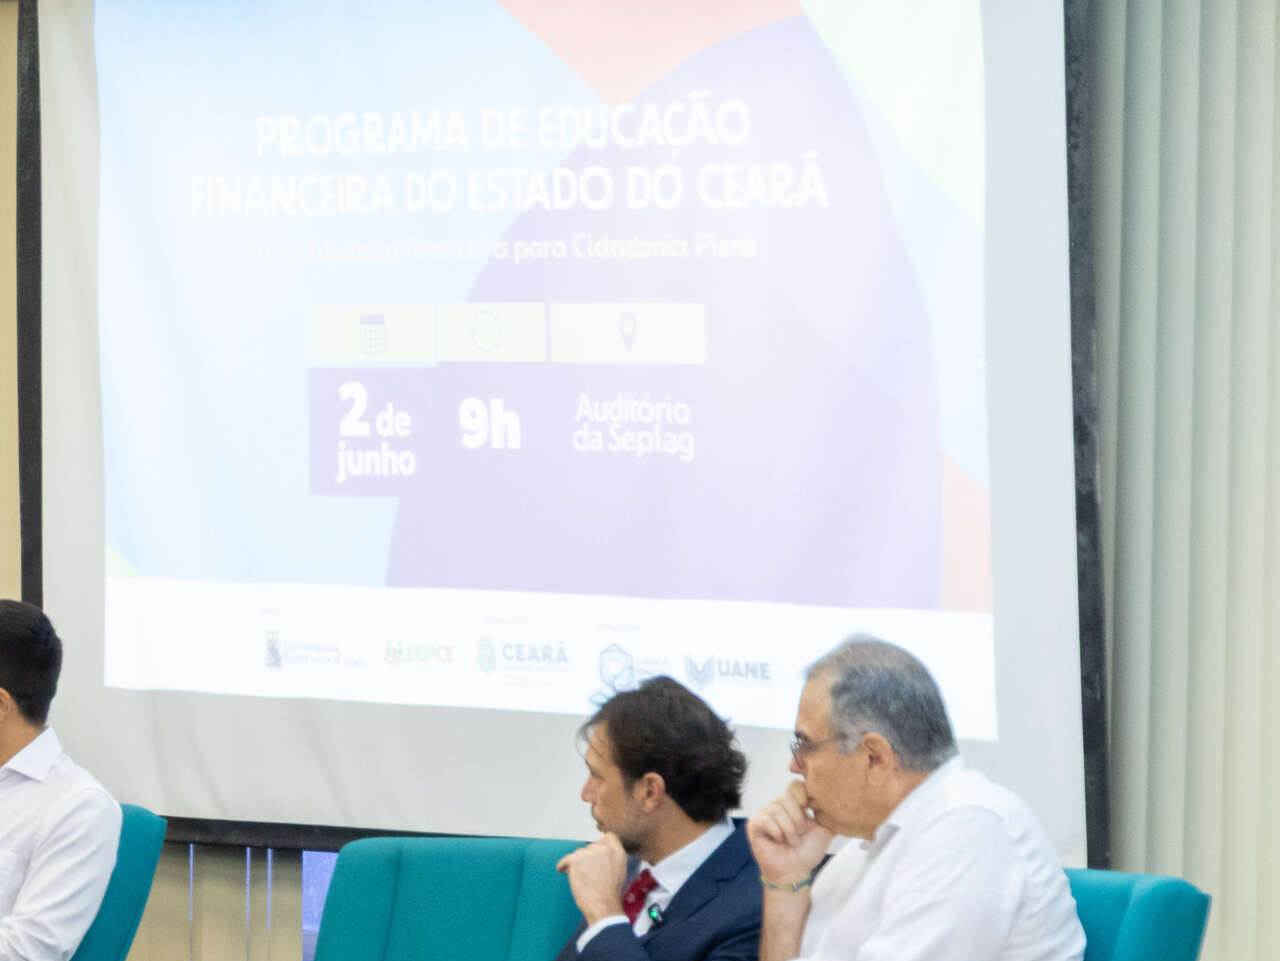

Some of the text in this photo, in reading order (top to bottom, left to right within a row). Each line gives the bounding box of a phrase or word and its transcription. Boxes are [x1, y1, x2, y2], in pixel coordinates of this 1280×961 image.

[257, 90, 751, 158] PROGRAMA DE EDUCAÇÃO
[189, 148, 831, 217] FINANCEIRA DO ESTADO DO CEARÁ
[513, 240, 568, 264] para
[572, 231, 689, 258] Cidadania
[338, 381, 412, 437] 2 de
[458, 396, 521, 449] 9h
[575, 393, 692, 426] Auditório
[336, 441, 416, 483] junho
[572, 424, 696, 462] da Seplag
[502, 640, 569, 665] CEARÁ
[718, 659, 773, 681] UANE
